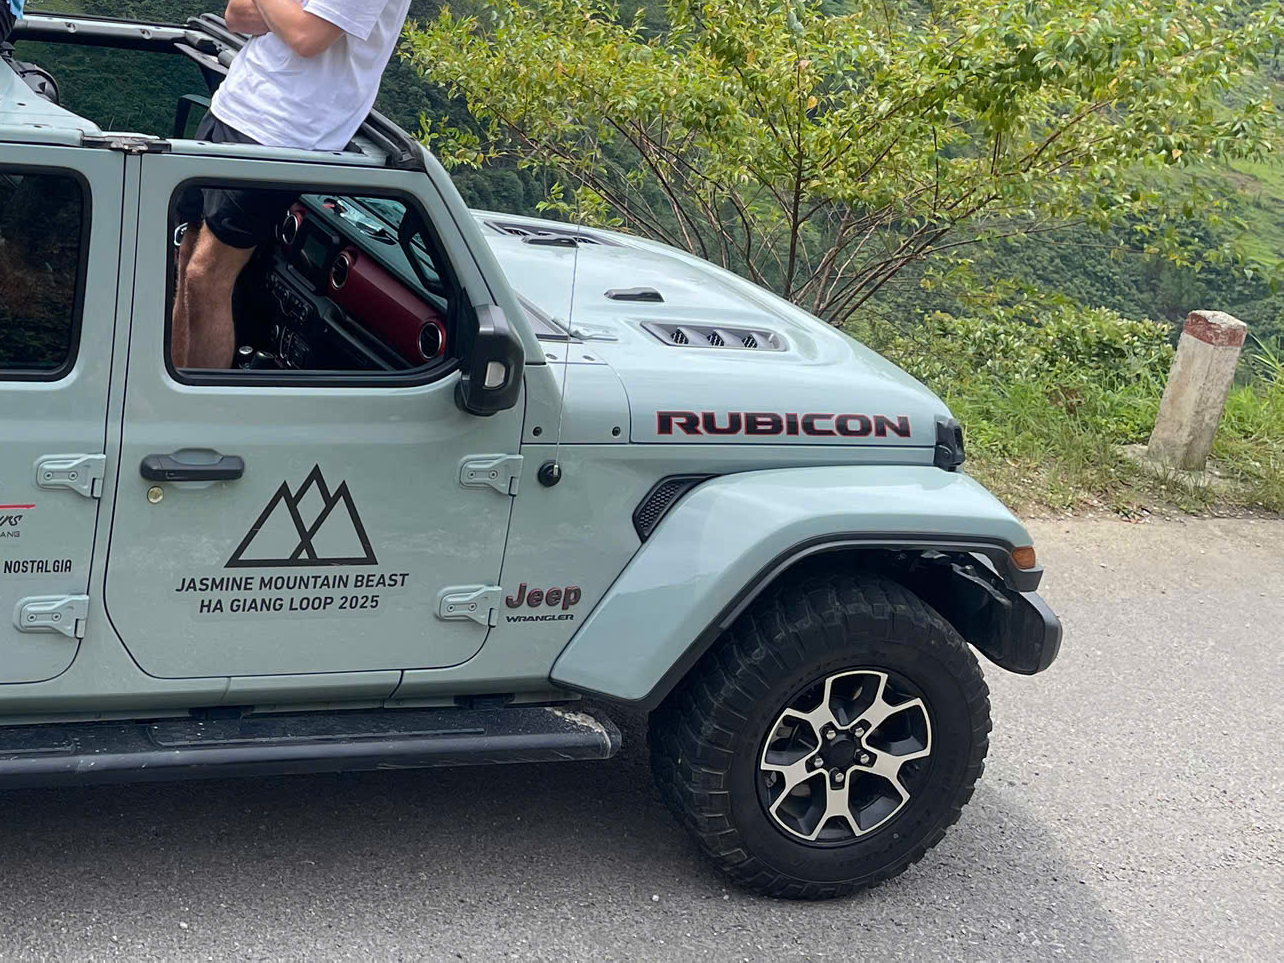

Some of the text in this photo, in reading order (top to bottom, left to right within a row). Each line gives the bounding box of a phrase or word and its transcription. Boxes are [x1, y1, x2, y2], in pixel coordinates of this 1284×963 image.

[657, 411, 911, 438] RUBICON
[3, 559, 72, 574] NOSTALGIA
[176, 573, 410, 593] JASMINE MOUNTAIN BEAST
[199, 595, 380, 614] HA GIANG LOOP 2025
[505, 582, 582, 611] Jeep
[506, 614, 575, 623] WRANGLER
